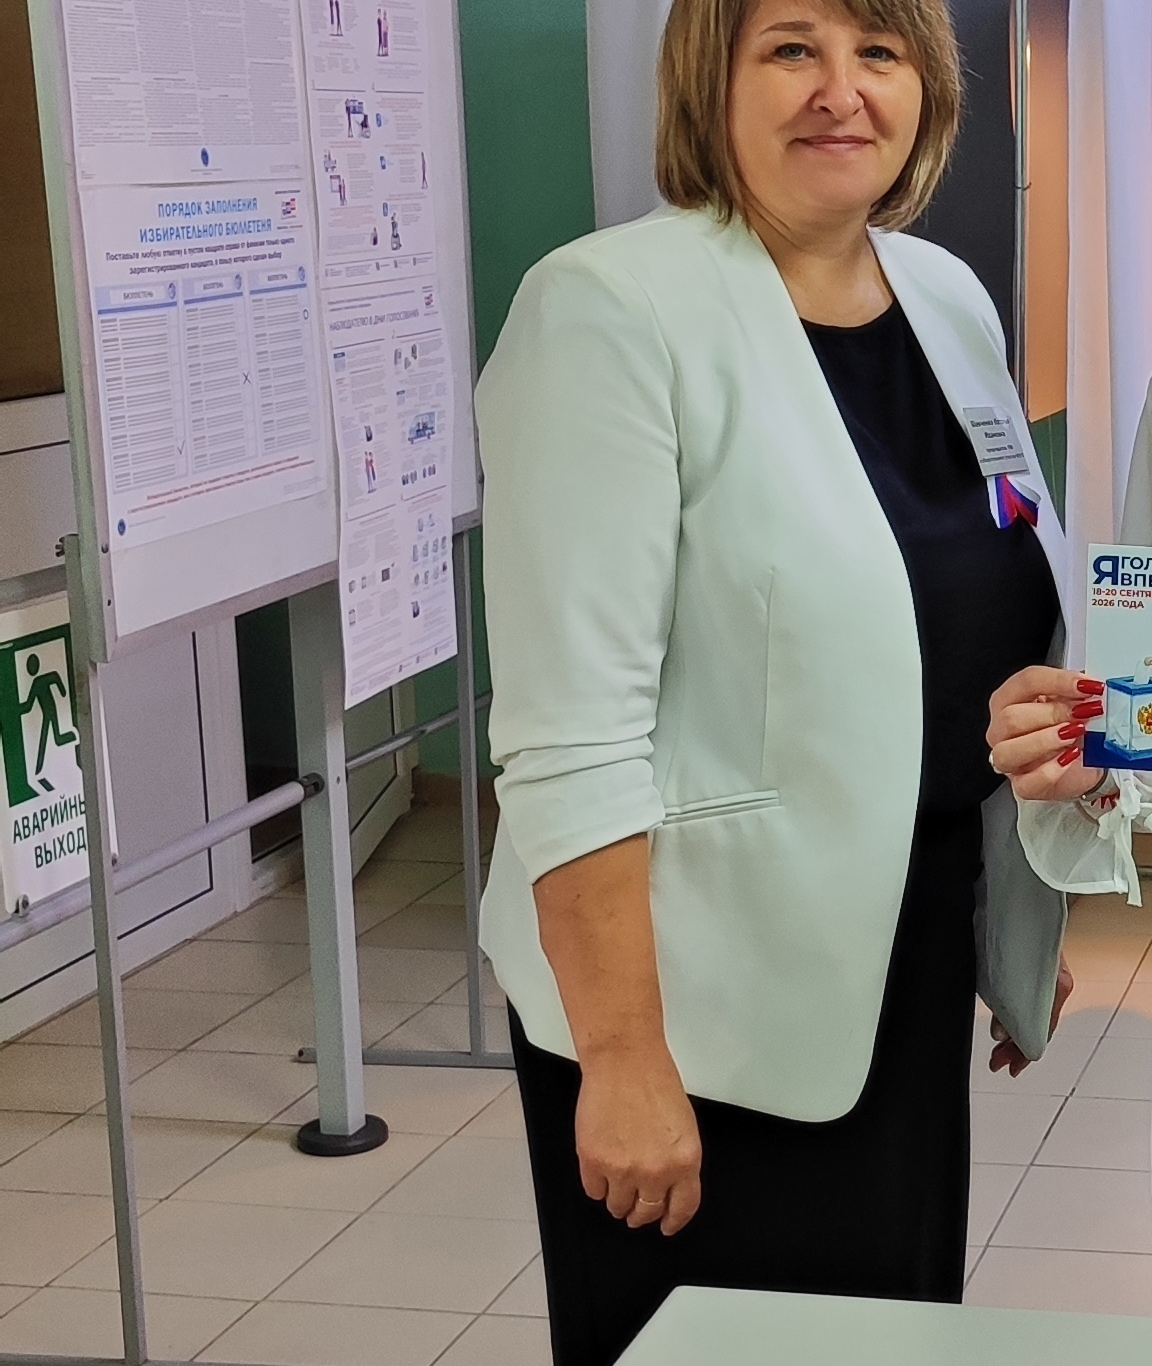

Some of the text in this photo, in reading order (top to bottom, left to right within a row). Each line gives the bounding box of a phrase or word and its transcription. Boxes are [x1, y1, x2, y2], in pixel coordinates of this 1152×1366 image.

[157, 197, 258, 219] ПОРЯДОК ЗАПОЛНЕНИЯ
[139, 218, 272, 244] ИЗБИРАТЕЛЬНОГО БЮЛЛЕТЕНЯ
[105, 251, 139, 262] Поставьте
[141, 248, 161, 260] любую
[1093, 555, 1120, 586] Я
[1092, 587, 1117, 597] 18-20
[1092, 598, 1145, 610] 2026 ГОДА
[34, 826, 87, 869] ВЫХОД
